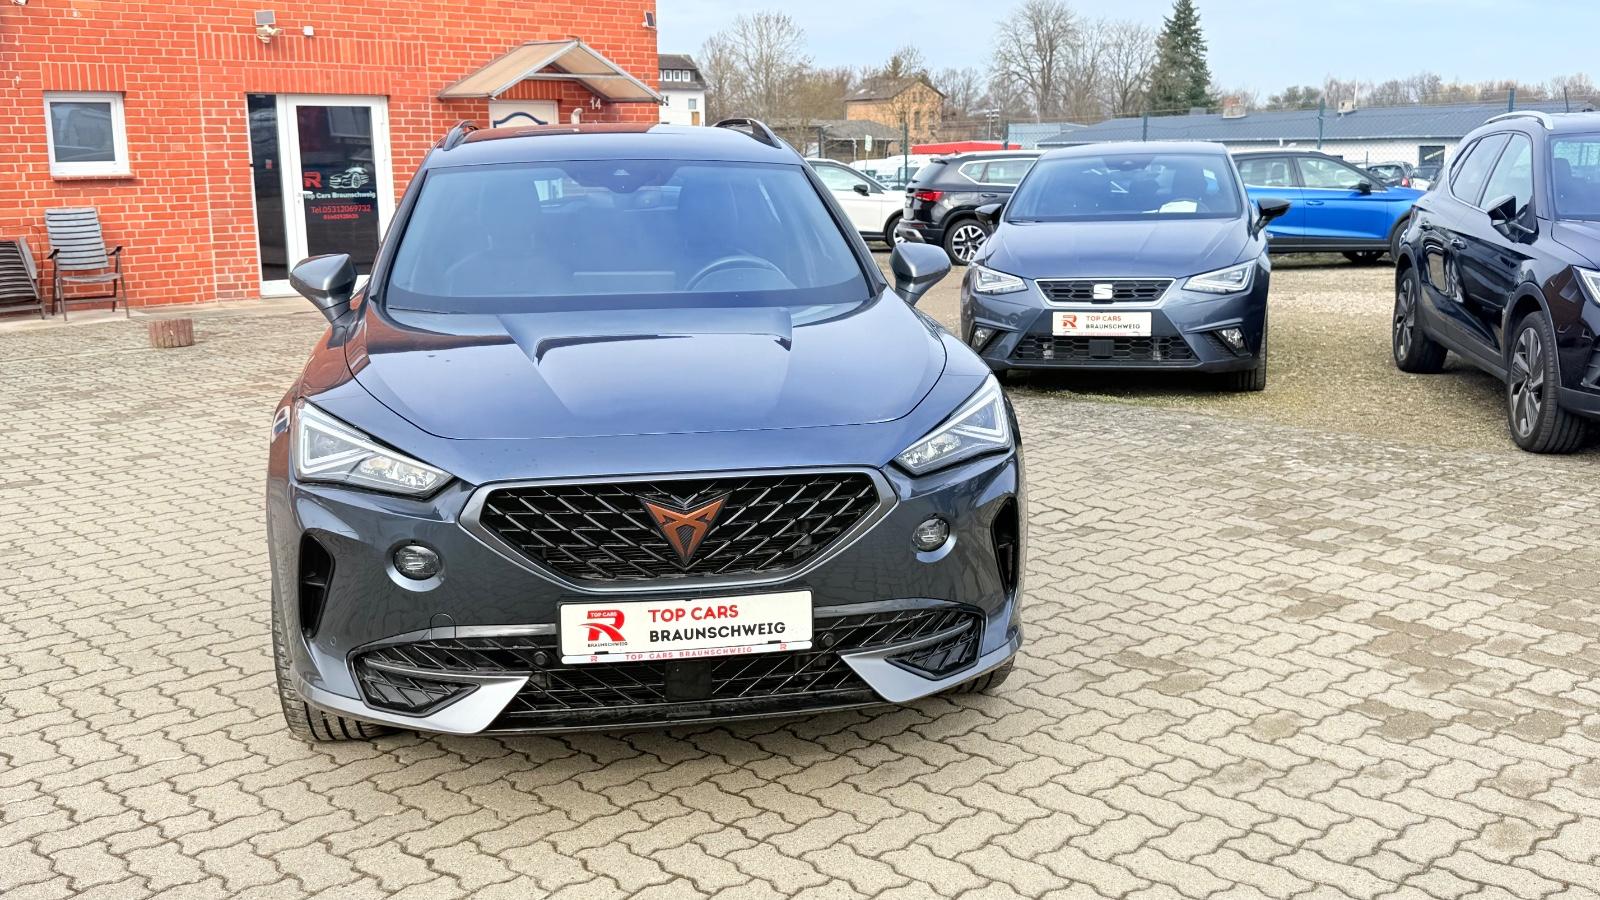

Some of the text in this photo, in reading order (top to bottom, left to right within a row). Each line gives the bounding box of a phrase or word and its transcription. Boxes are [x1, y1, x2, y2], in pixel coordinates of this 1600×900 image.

[590, 97, 601, 110] 14
[332, 191, 376, 199] Braunschweig
[648, 604, 739, 622] TOP CARS
[649, 622, 785, 642] BRAUNSCHWEIG
[679, 646, 752, 658] BRAUNSCHWEIG
